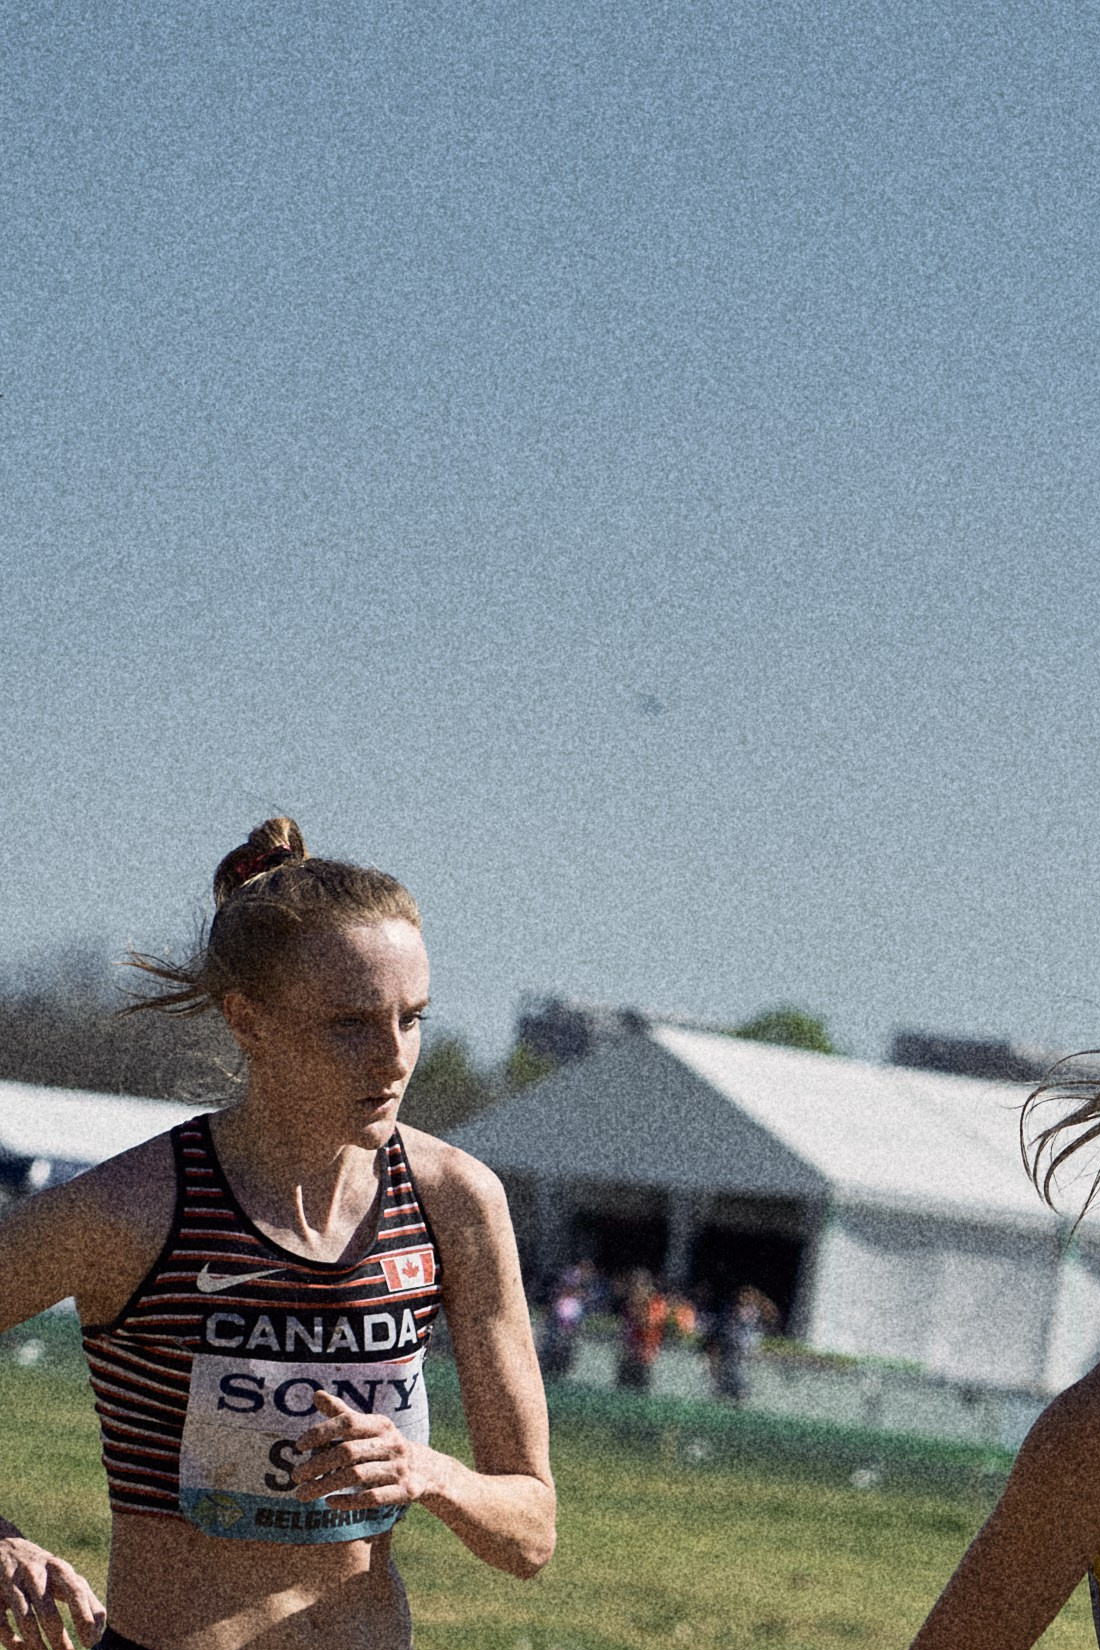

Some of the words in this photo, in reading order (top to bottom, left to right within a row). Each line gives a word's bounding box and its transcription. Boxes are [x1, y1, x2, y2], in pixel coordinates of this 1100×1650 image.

[205, 1308, 418, 1353] CANADA
[217, 1372, 419, 1417] SONY
[254, 1508, 380, 1530] BELGRADE
